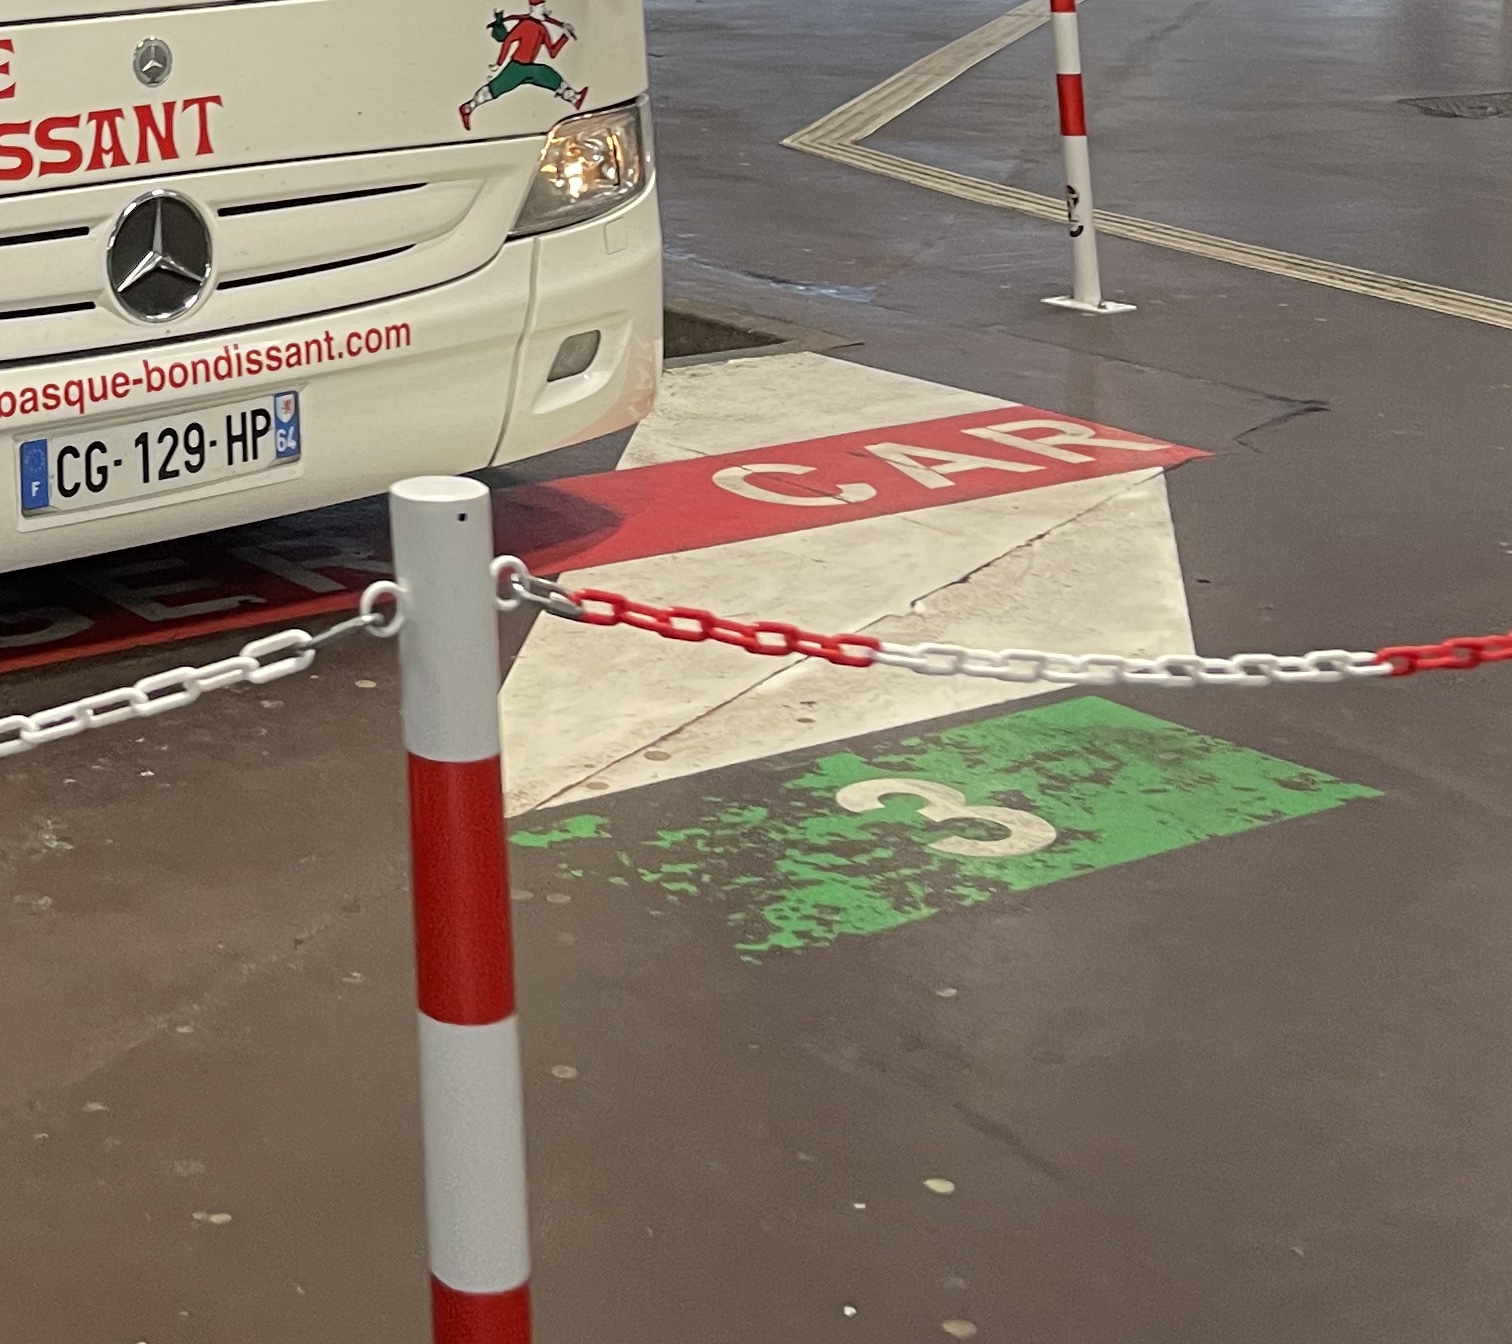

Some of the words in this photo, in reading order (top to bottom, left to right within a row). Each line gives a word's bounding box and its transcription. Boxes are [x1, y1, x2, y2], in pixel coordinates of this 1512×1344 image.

[276, 426, 297, 453] 64
[711, 418, 1174, 507] CAR
[31, 481, 40, 497] F
[835, 778, 1057, 857] 3
